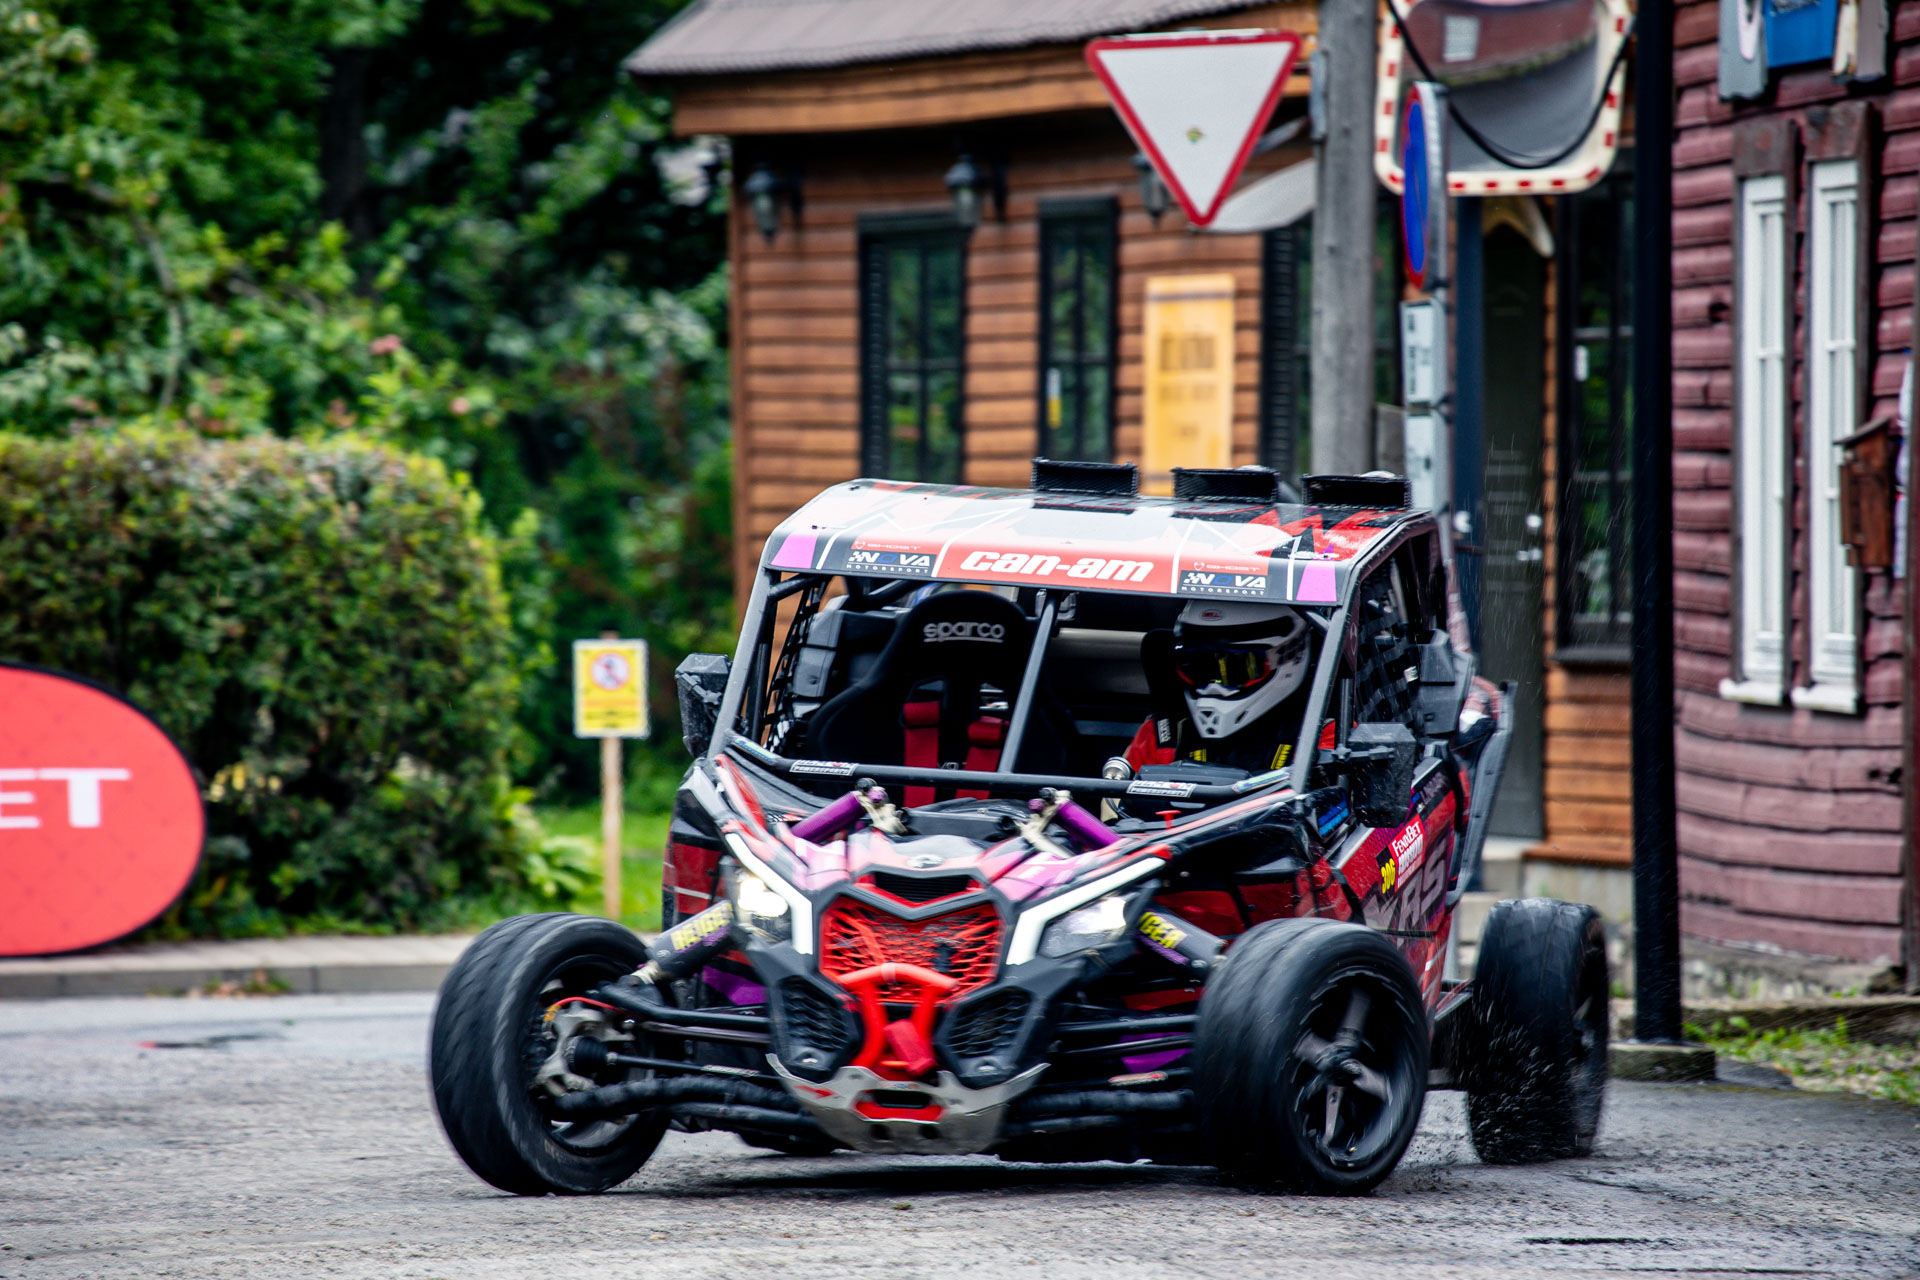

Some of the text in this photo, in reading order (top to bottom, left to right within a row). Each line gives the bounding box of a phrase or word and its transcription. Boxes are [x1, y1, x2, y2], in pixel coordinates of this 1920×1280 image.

[848, 551, 930, 567] NOVA
[960, 551, 1155, 582] can-am
[846, 564, 929, 574] MOTORSPORT
[1184, 573, 1266, 588] NOVA
[1181, 586, 1265, 596] MOTORSPORT
[923, 621, 1006, 643] sparco
